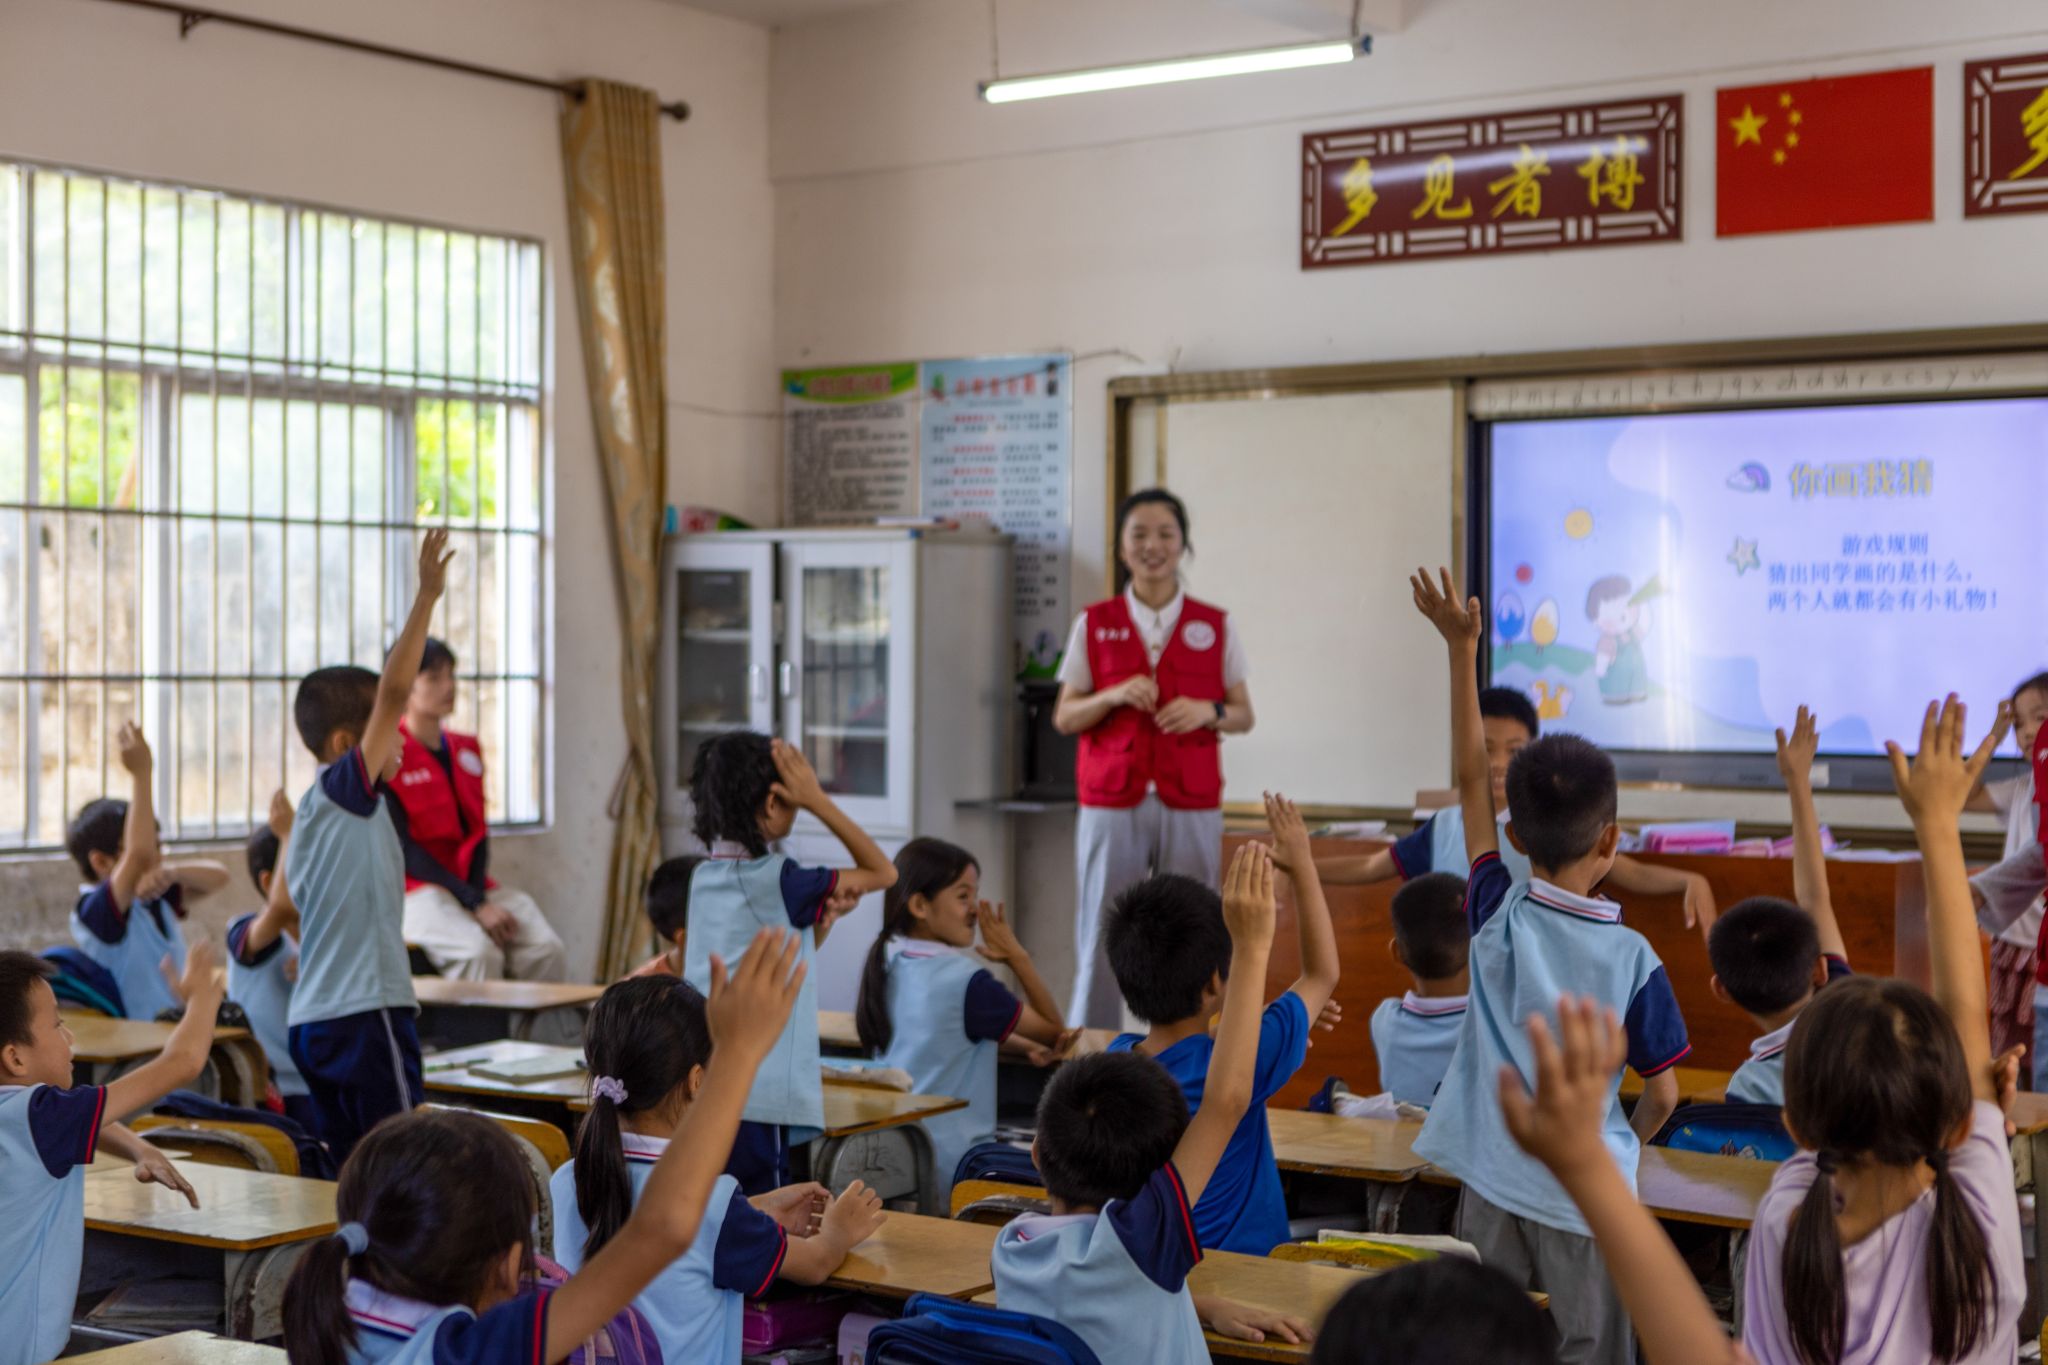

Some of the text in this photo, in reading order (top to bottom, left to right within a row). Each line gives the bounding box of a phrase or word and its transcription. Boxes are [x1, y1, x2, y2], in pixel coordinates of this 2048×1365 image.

[1331, 133, 1648, 237] 多见者博
[1790, 459, 1933, 497] 你画我猜
[1842, 533, 1928, 556] 游戏规则
